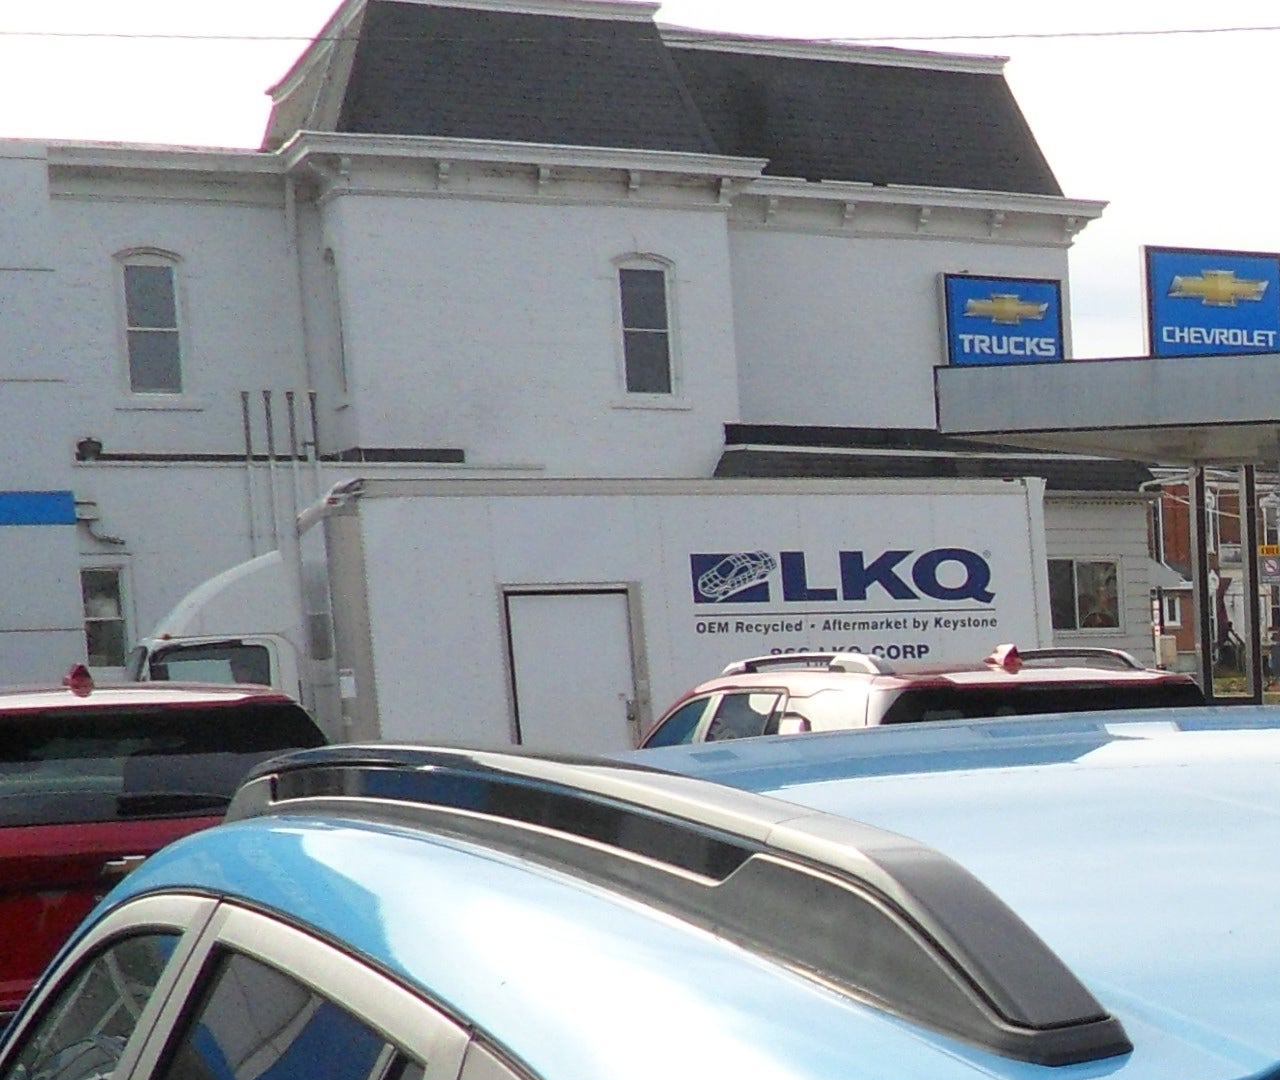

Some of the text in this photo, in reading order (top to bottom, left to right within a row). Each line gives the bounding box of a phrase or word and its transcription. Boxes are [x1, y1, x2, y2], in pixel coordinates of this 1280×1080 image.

[959, 334, 1056, 356] TRUCKS
[1162, 326, 1277, 347] CHEVROLET
[779, 547, 996, 604] LKQ
[696, 616, 998, 635] OEM Recycled Aftermarket by Keystone
[872, 644, 930, 660] CORP
